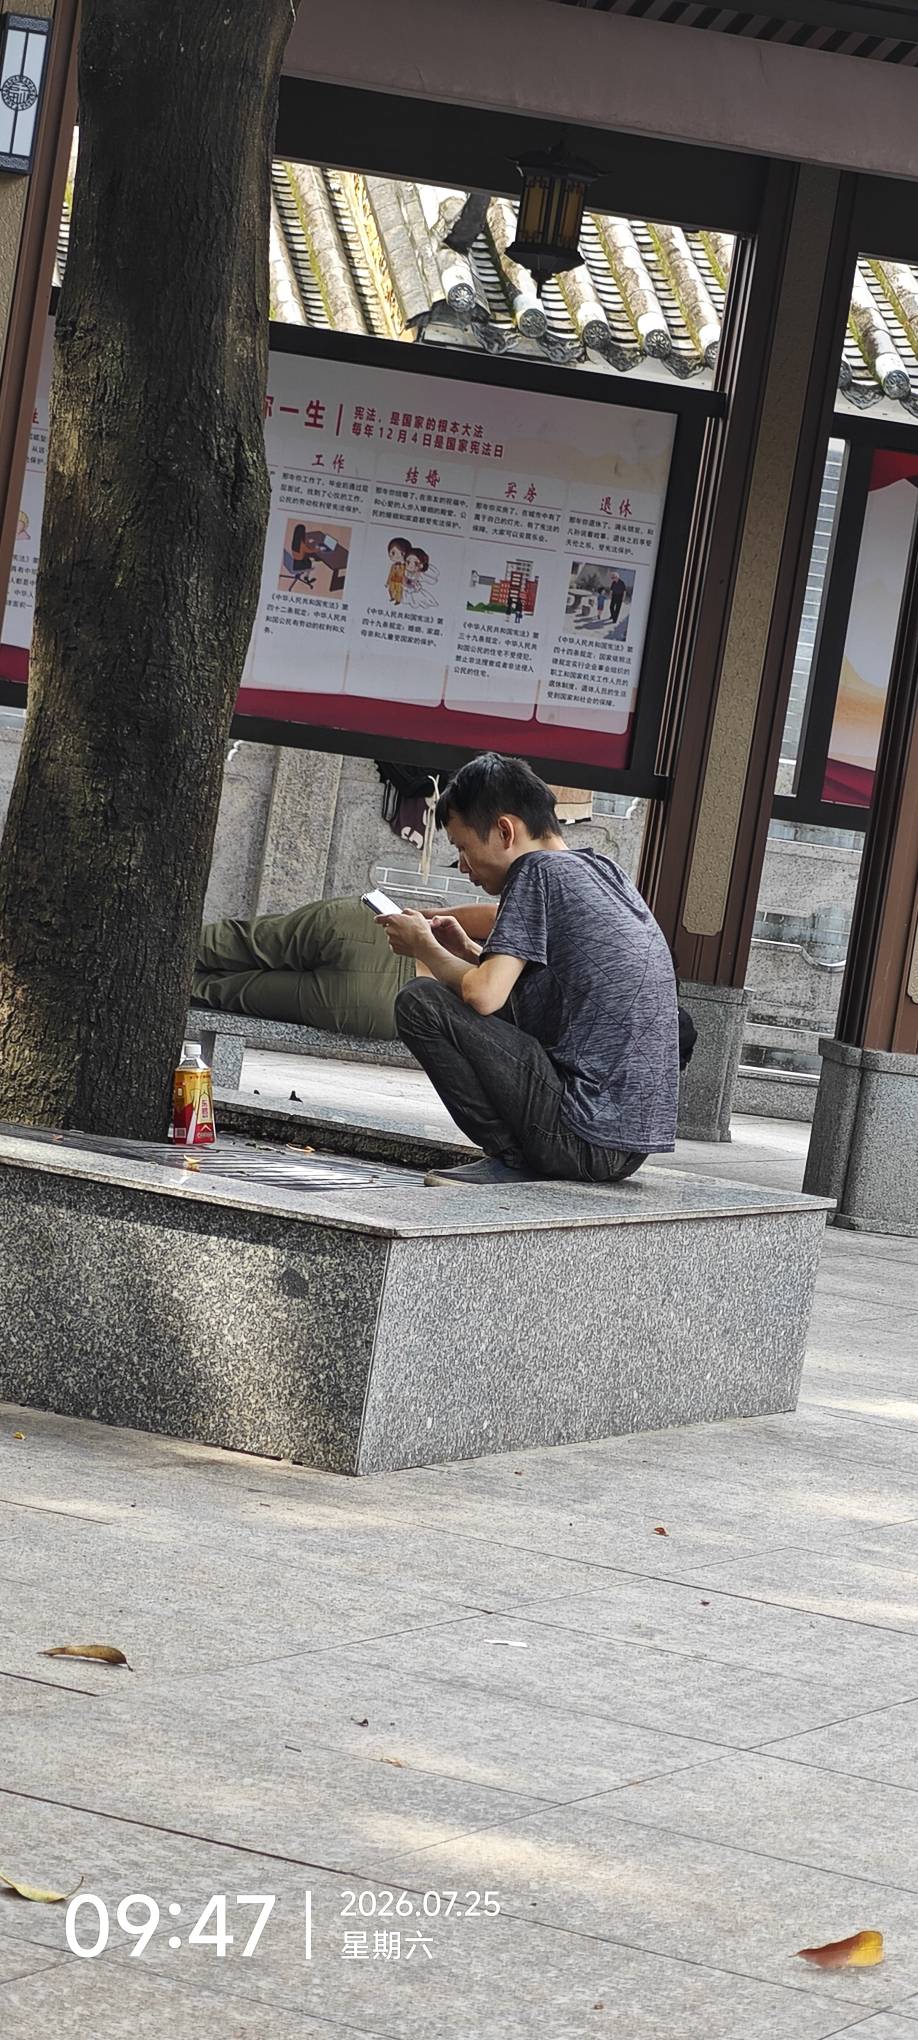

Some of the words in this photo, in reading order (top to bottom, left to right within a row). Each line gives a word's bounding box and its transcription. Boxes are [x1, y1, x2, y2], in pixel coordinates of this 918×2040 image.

[351, 421, 504, 458] 每年12月4日是国家宪法日
[312, 453, 345, 473] 工作
[405, 466, 440, 488] 结婚
[505, 481, 537, 503] 买房
[600, 496, 633, 518] 退休
